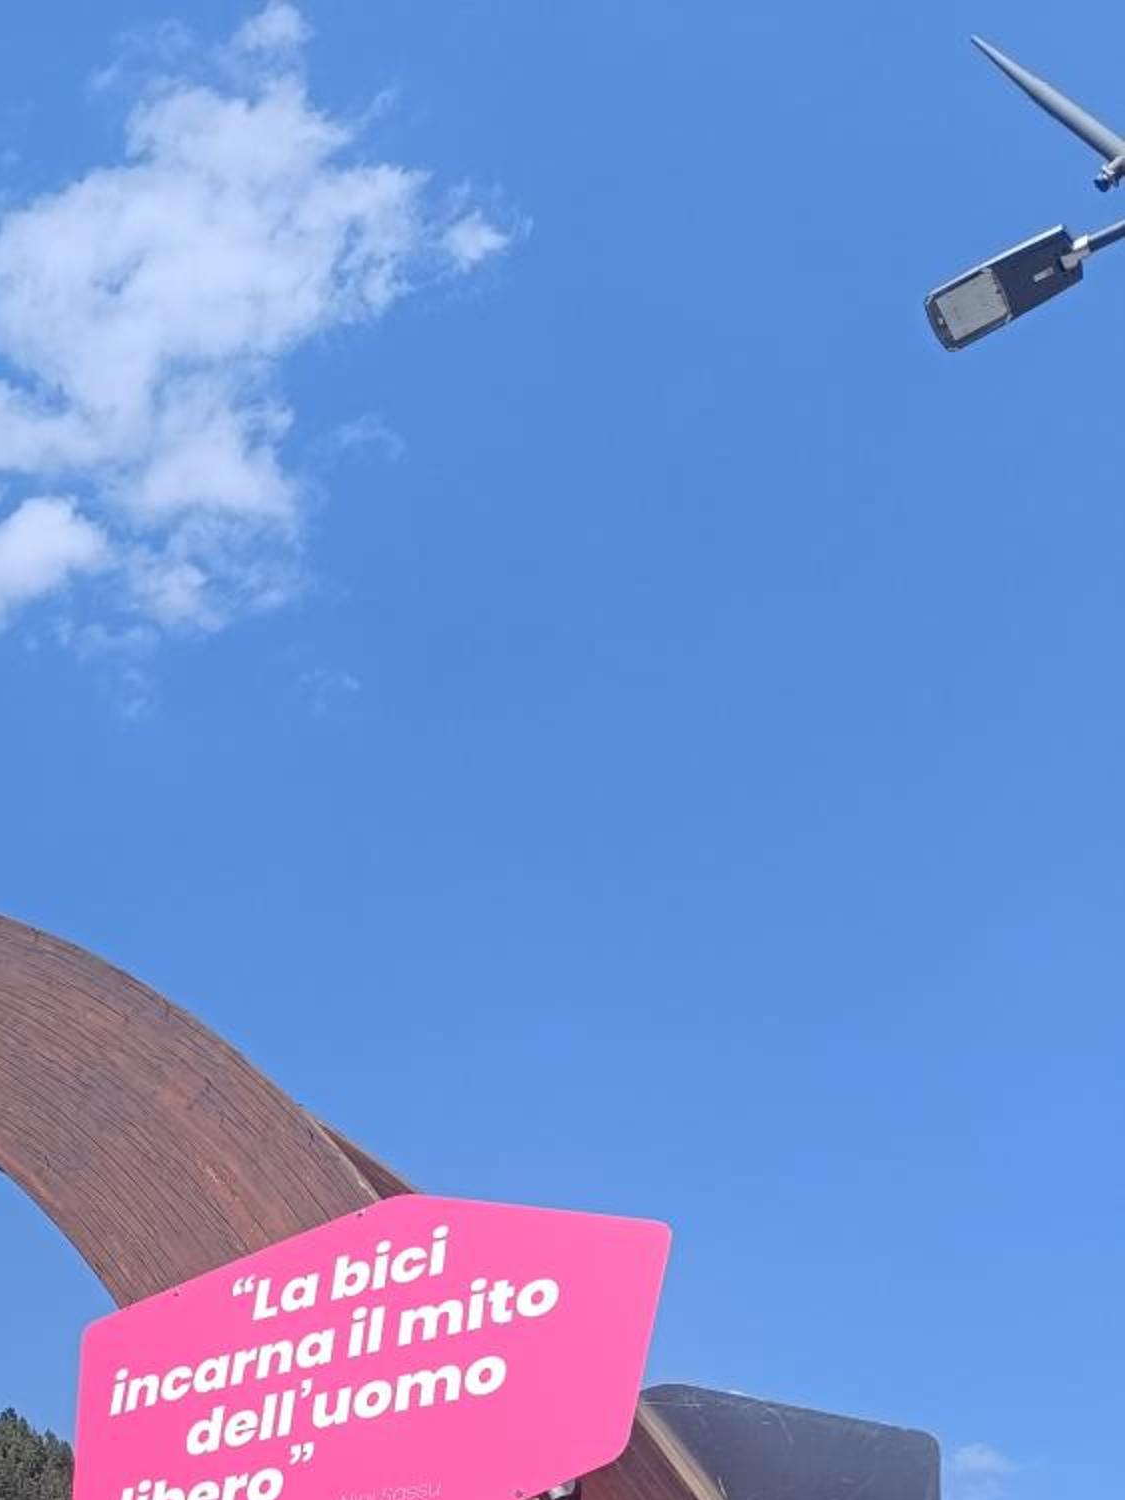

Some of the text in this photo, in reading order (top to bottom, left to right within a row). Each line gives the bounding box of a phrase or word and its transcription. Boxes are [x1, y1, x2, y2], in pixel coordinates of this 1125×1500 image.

[331, 1226, 449, 1300] bici
[108, 1277, 560, 1416] incarna il mito
[186, 1355, 507, 1456] dell'uomo
